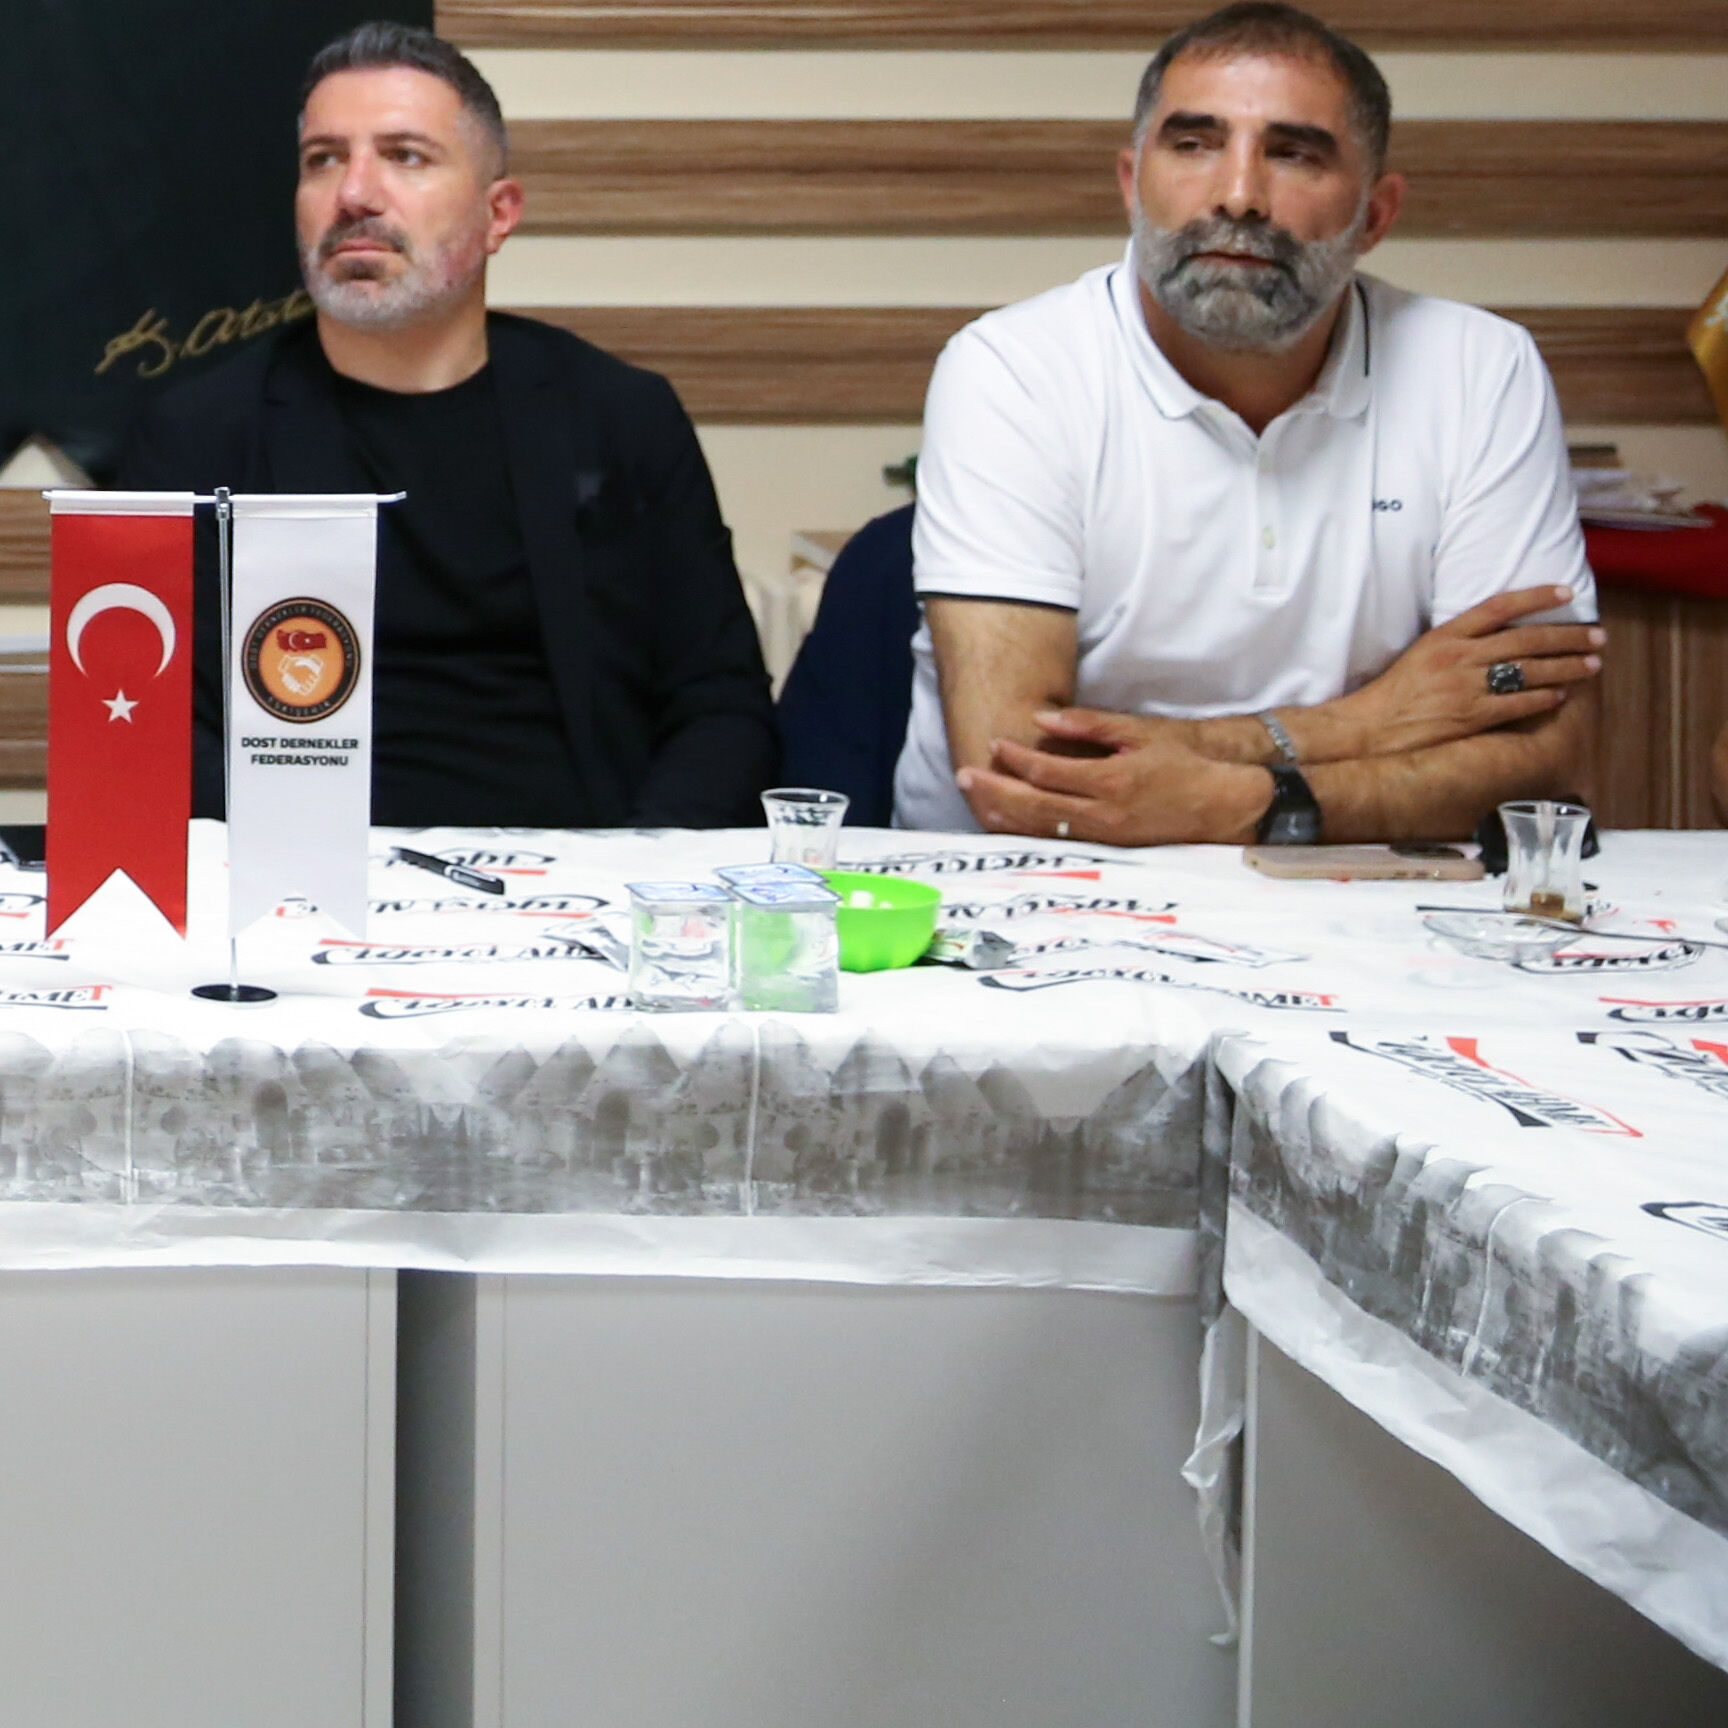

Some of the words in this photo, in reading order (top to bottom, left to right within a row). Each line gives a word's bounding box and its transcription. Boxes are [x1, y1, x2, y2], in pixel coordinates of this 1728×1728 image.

[241, 737, 277, 748] DOST
[280, 738, 359, 749] DERNEKLER
[251, 754, 349, 766] FEDERASYONU
